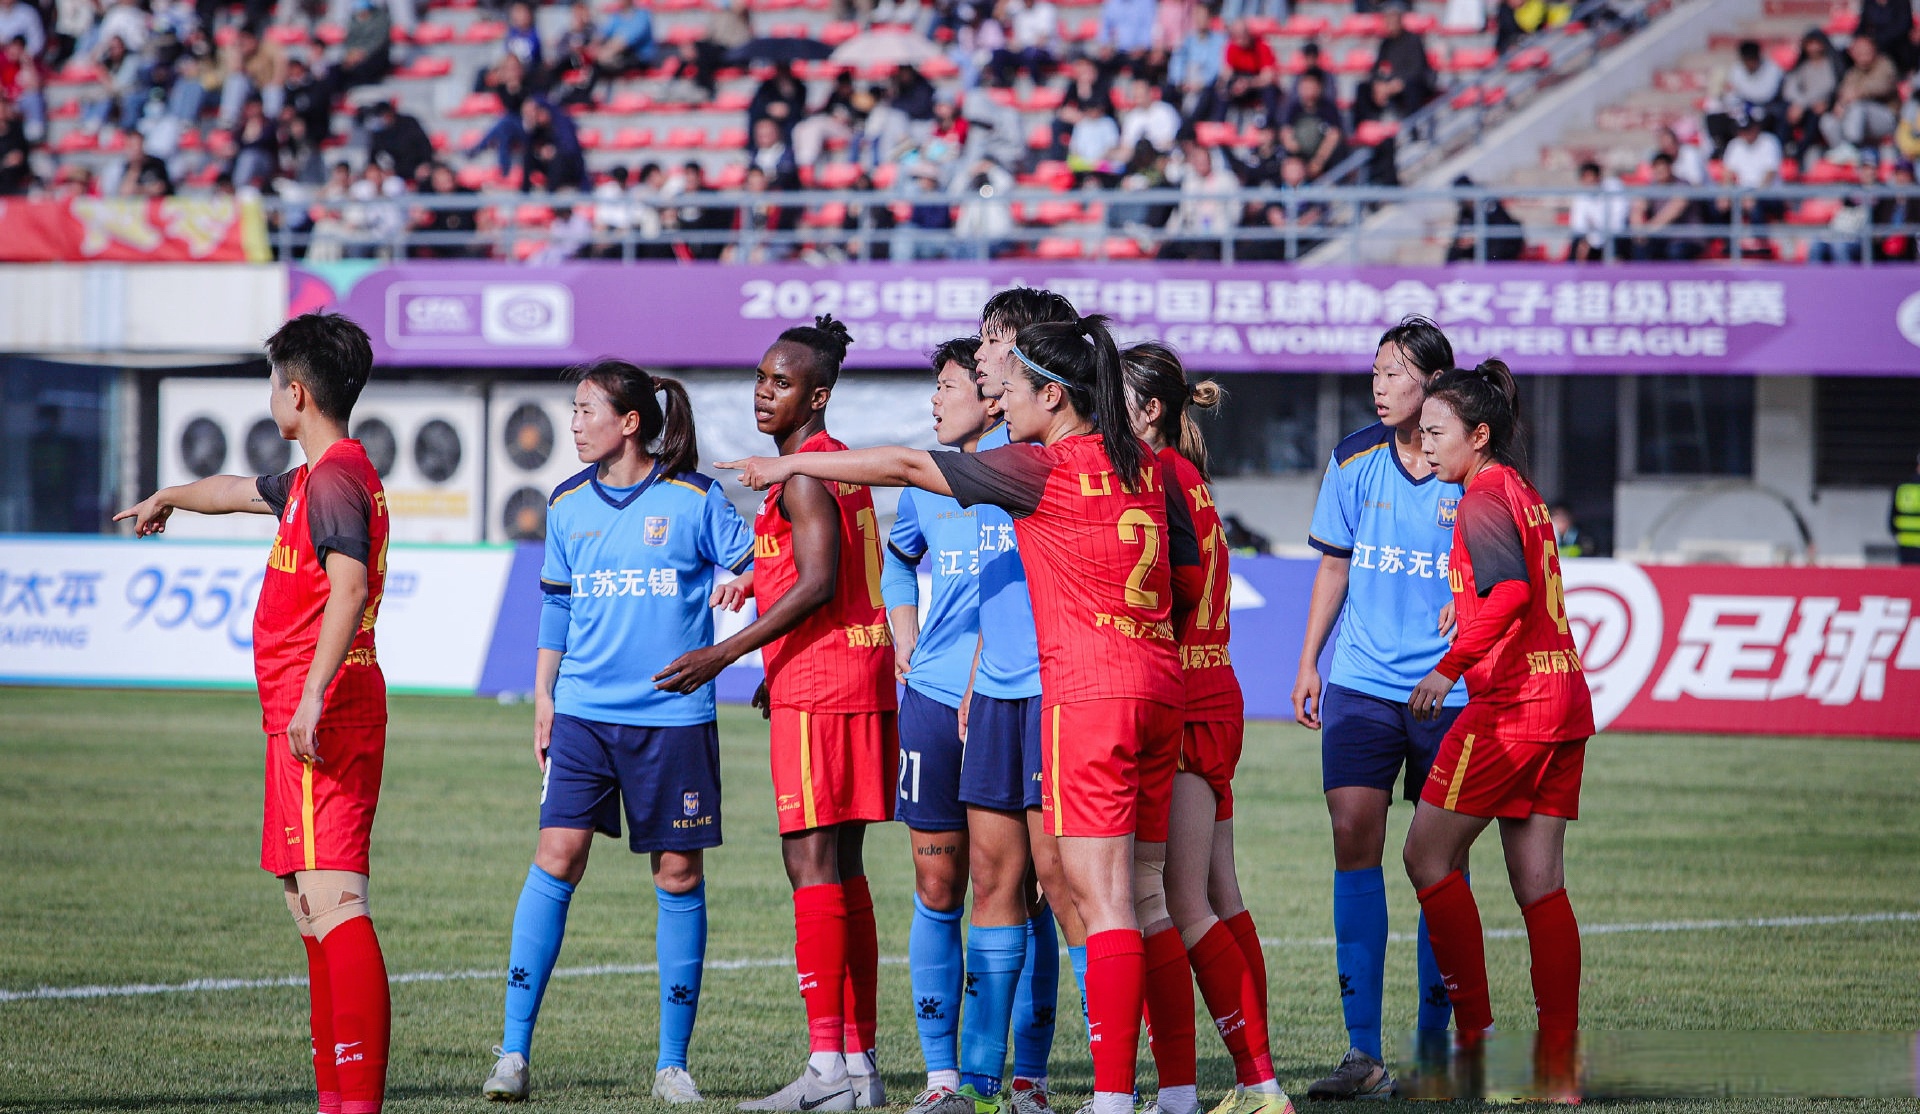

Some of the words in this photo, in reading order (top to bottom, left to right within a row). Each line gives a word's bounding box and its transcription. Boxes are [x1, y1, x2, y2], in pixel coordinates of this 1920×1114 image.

[739, 277, 1787, 327] 2025中国平中国足球协会女子超级联赛
[1164, 325, 1244, 354] CFA
[1571, 327, 1728, 356] LEAGUE
[980, 523, 1020, 553] 江苏
[1117, 508, 1160, 609] 2
[0, 569, 104, 617] 太平
[571, 568, 679, 598] 江苏无锡
[1651, 595, 1920, 705] 足球
[899, 748, 921, 803] 21
[673, 815, 712, 829] KELME
